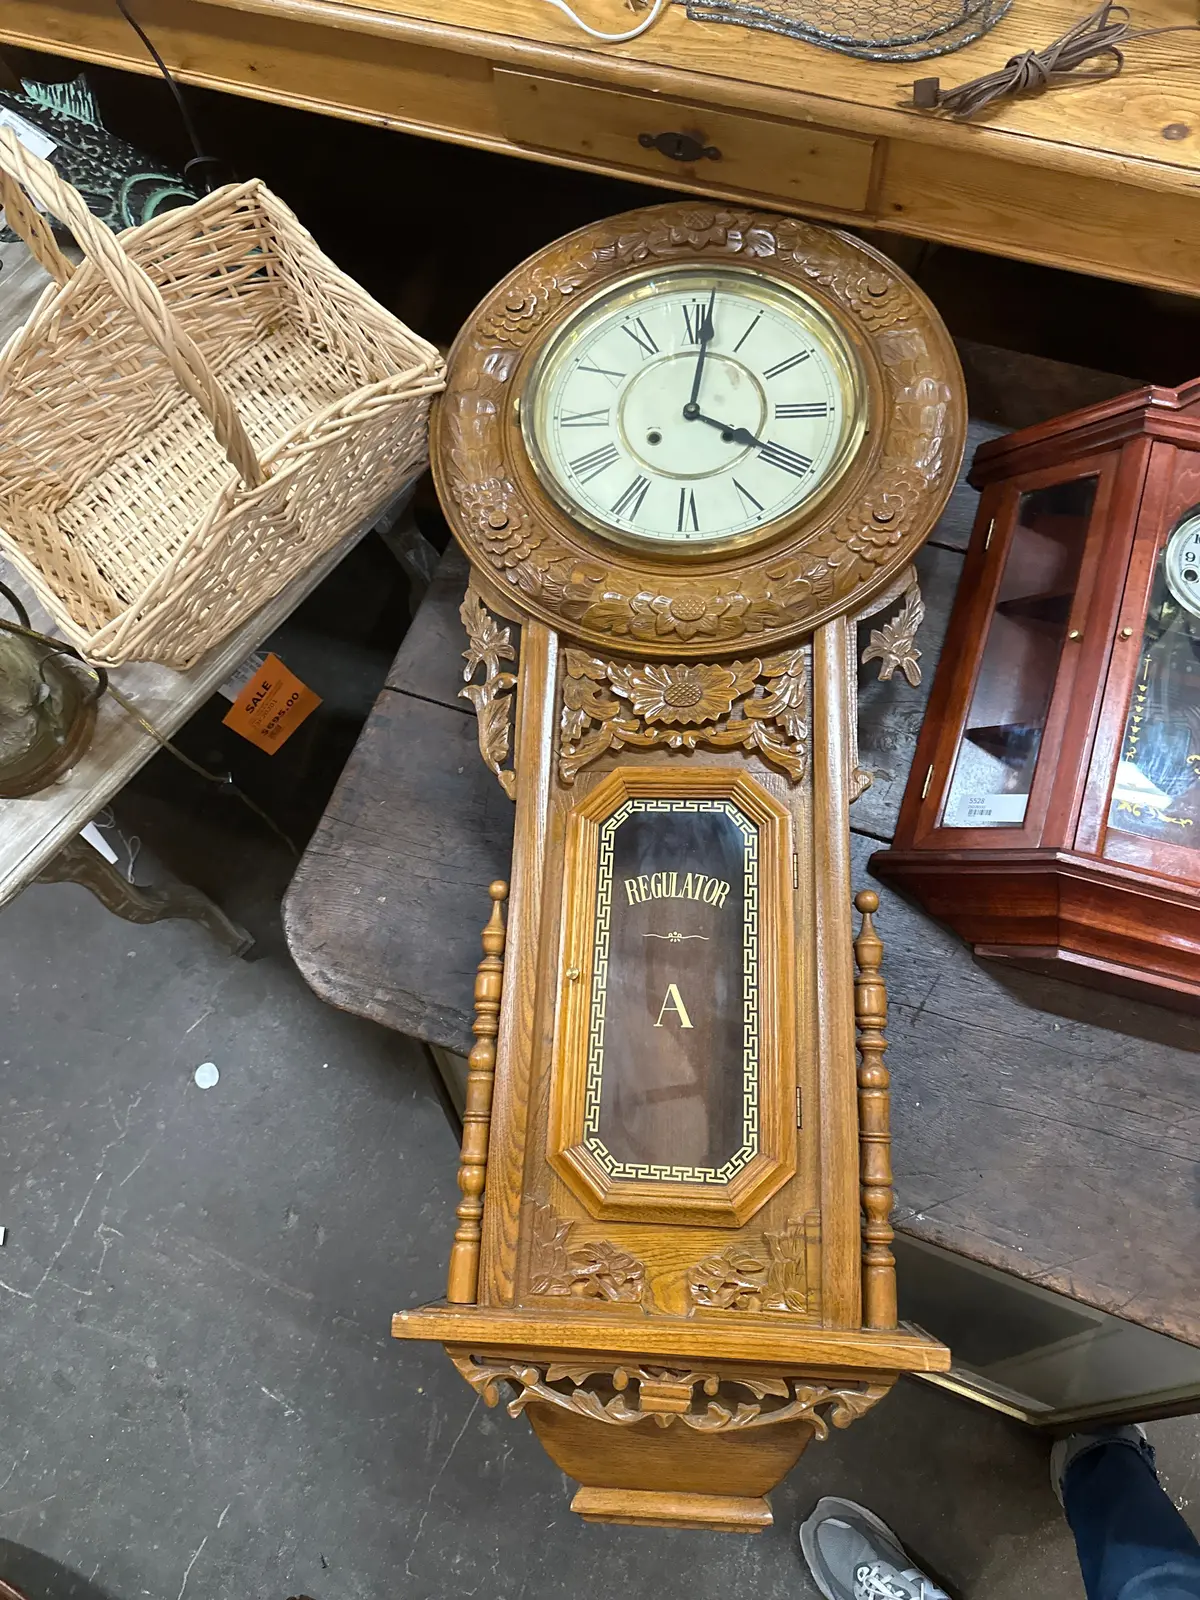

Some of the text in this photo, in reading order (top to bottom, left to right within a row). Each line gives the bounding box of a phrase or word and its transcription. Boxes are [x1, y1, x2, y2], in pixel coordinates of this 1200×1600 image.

[620, 317, 662, 361] XI
[732, 314, 761, 353] I
[576, 355, 627, 389] X
[762, 349, 811, 380] II
[560, 408, 611, 428] IX
[774, 402, 828, 420] III
[568, 442, 622, 486] VIII
[610, 474, 653, 523] VII
[677, 487, 701, 532] VI
[732, 476, 766, 518] V
[1185, 551, 1196, 562] 9
[245, 680, 272, 714] SALE
[261, 692, 299, 736] $695.00
[624, 871, 731, 909] REGULATOR
[653, 983, 694, 1029] A
